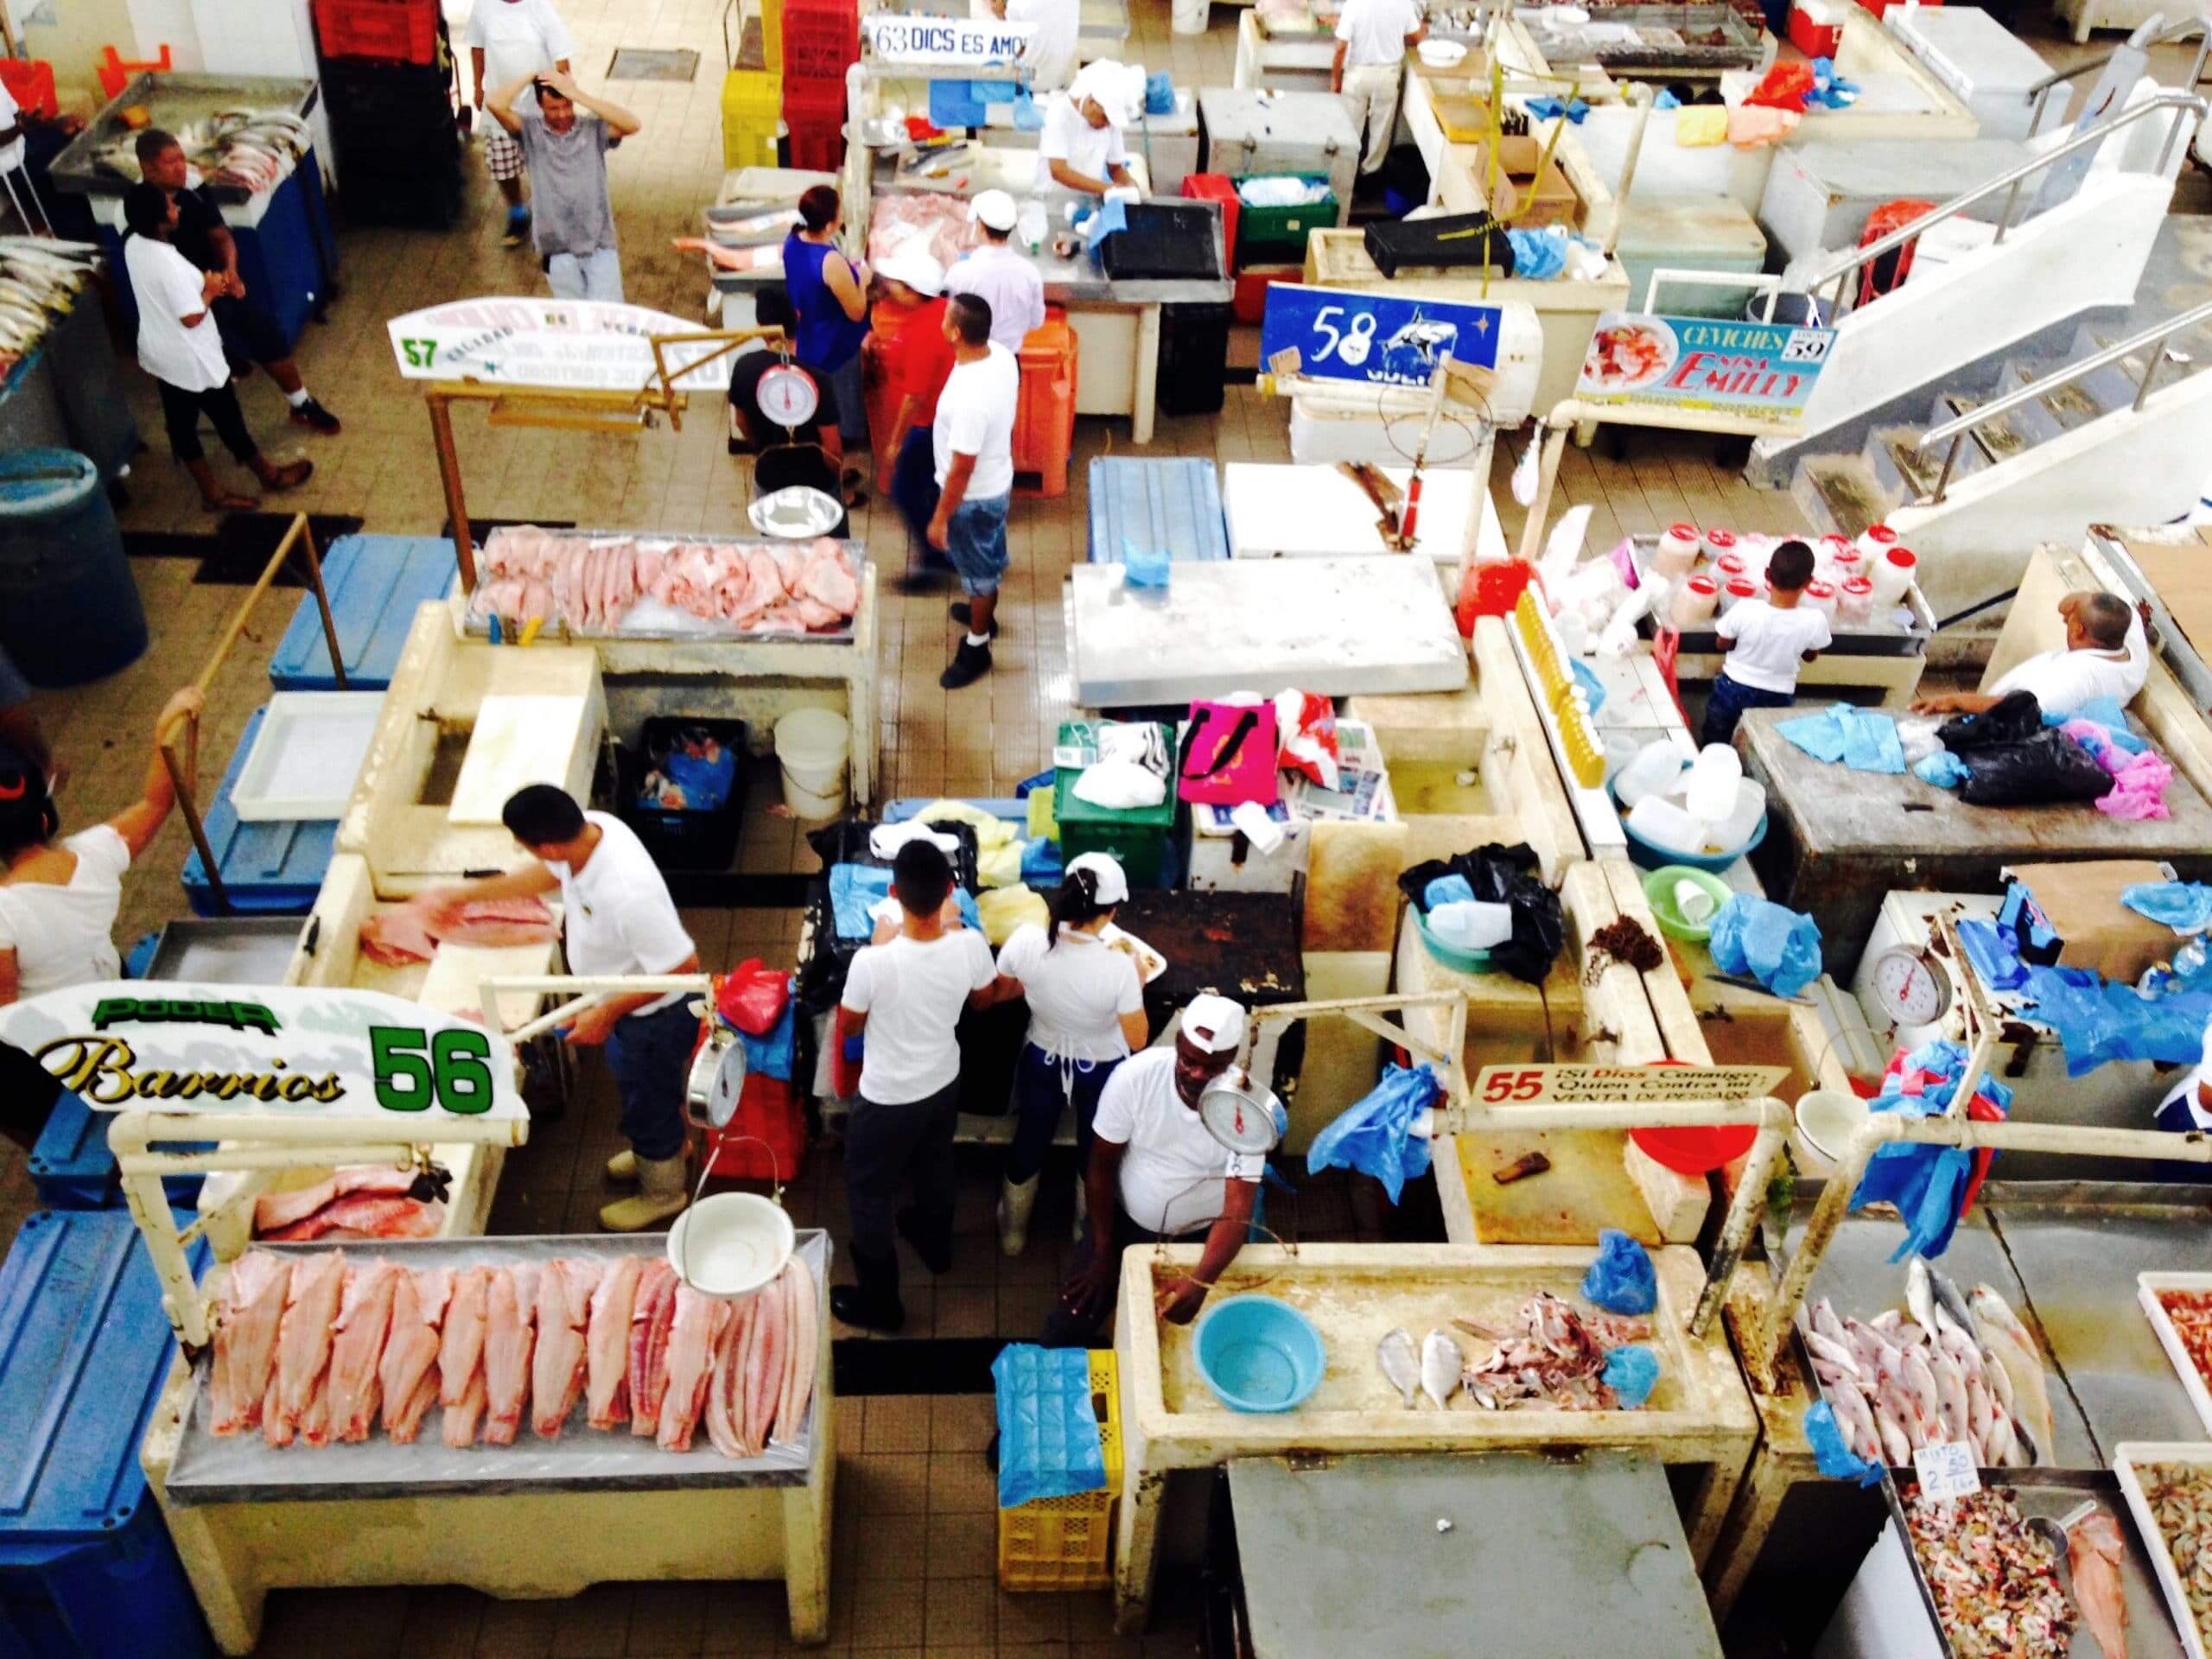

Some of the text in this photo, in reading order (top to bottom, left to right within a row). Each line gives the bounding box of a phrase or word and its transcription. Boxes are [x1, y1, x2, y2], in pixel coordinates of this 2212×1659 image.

[876, 25, 907, 54] 63
[962, 34, 983, 54] ES
[989, 35, 1028, 59] AMO
[1310, 305, 1377, 366] 58
[1784, 340, 1826, 359] 59
[401, 337, 438, 368] 57
[92, 998, 282, 1036] PODER
[34, 1035, 347, 1104] Barrios
[369, 1025, 494, 1115] 56
[1557, 1079, 1630, 1090] Quien
[1640, 1079, 1719, 1090] Contra
[1592, 1068, 1647, 1079] Dios
[1482, 1071, 1544, 1103] 55
[1552, 1091, 1628, 1103] VENTA
[1635, 1091, 1656, 1102] DE
